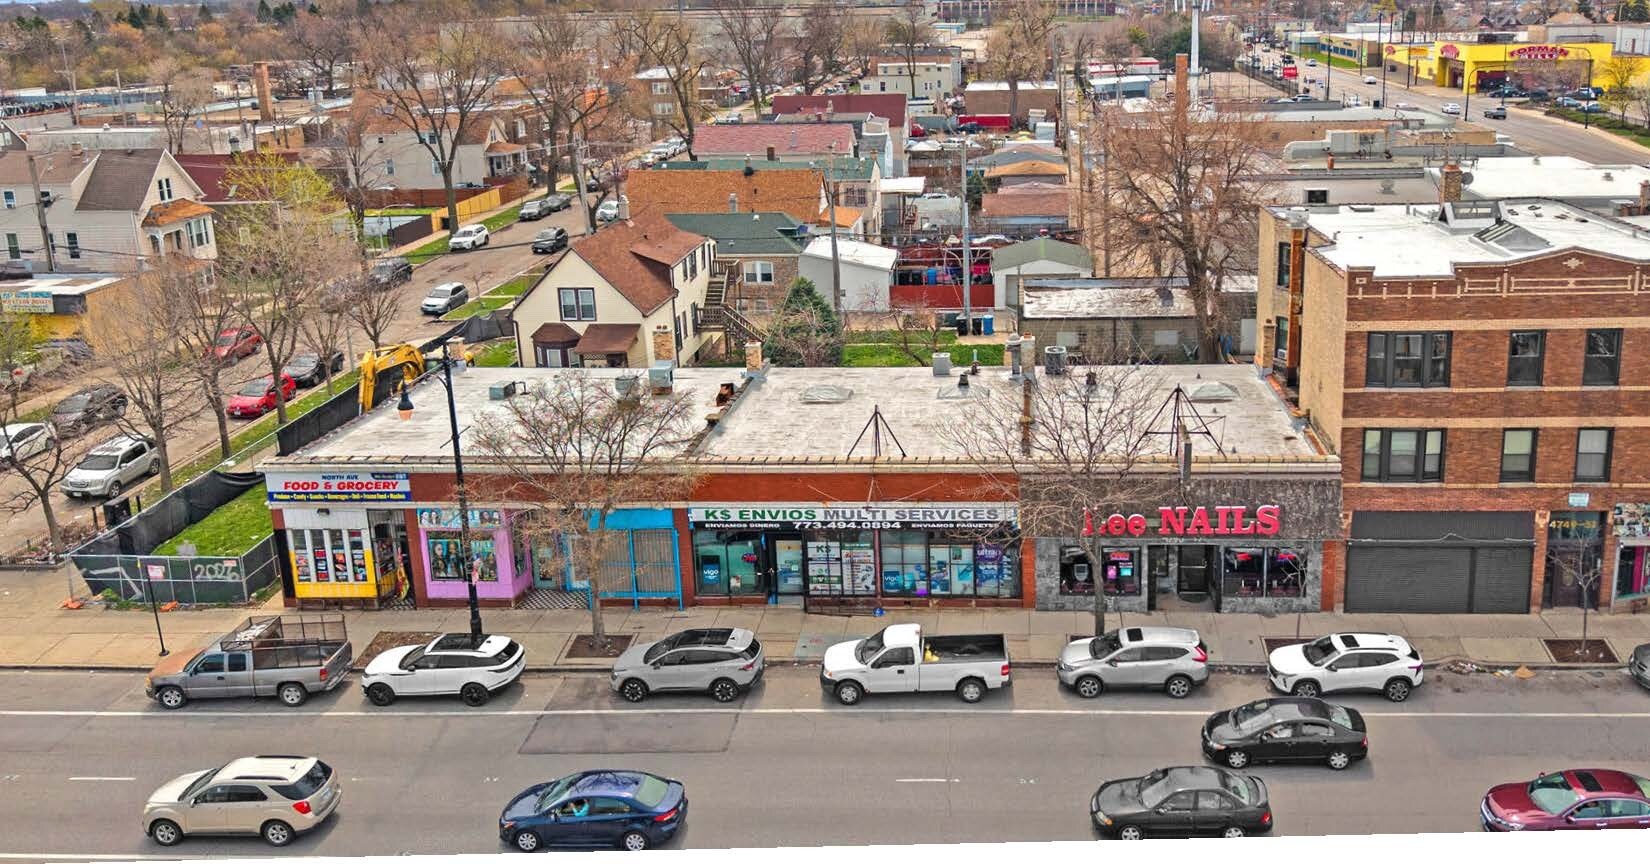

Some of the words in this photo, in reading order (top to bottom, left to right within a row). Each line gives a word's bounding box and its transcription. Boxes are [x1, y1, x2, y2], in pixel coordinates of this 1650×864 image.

[1509, 45, 1569, 58] FORMAN
[283, 480, 320, 491] FOOD
[324, 481, 333, 490] &
[336, 480, 399, 491] GROCERY
[738, 509, 816, 520] ENVIOS
[823, 509, 888, 521] MULTI
[895, 509, 999, 520] SERVICES
[1158, 504, 1281, 536] NAILS
[793, 521, 901, 529] 773.494.0894
[703, 568, 719, 576] vigo
